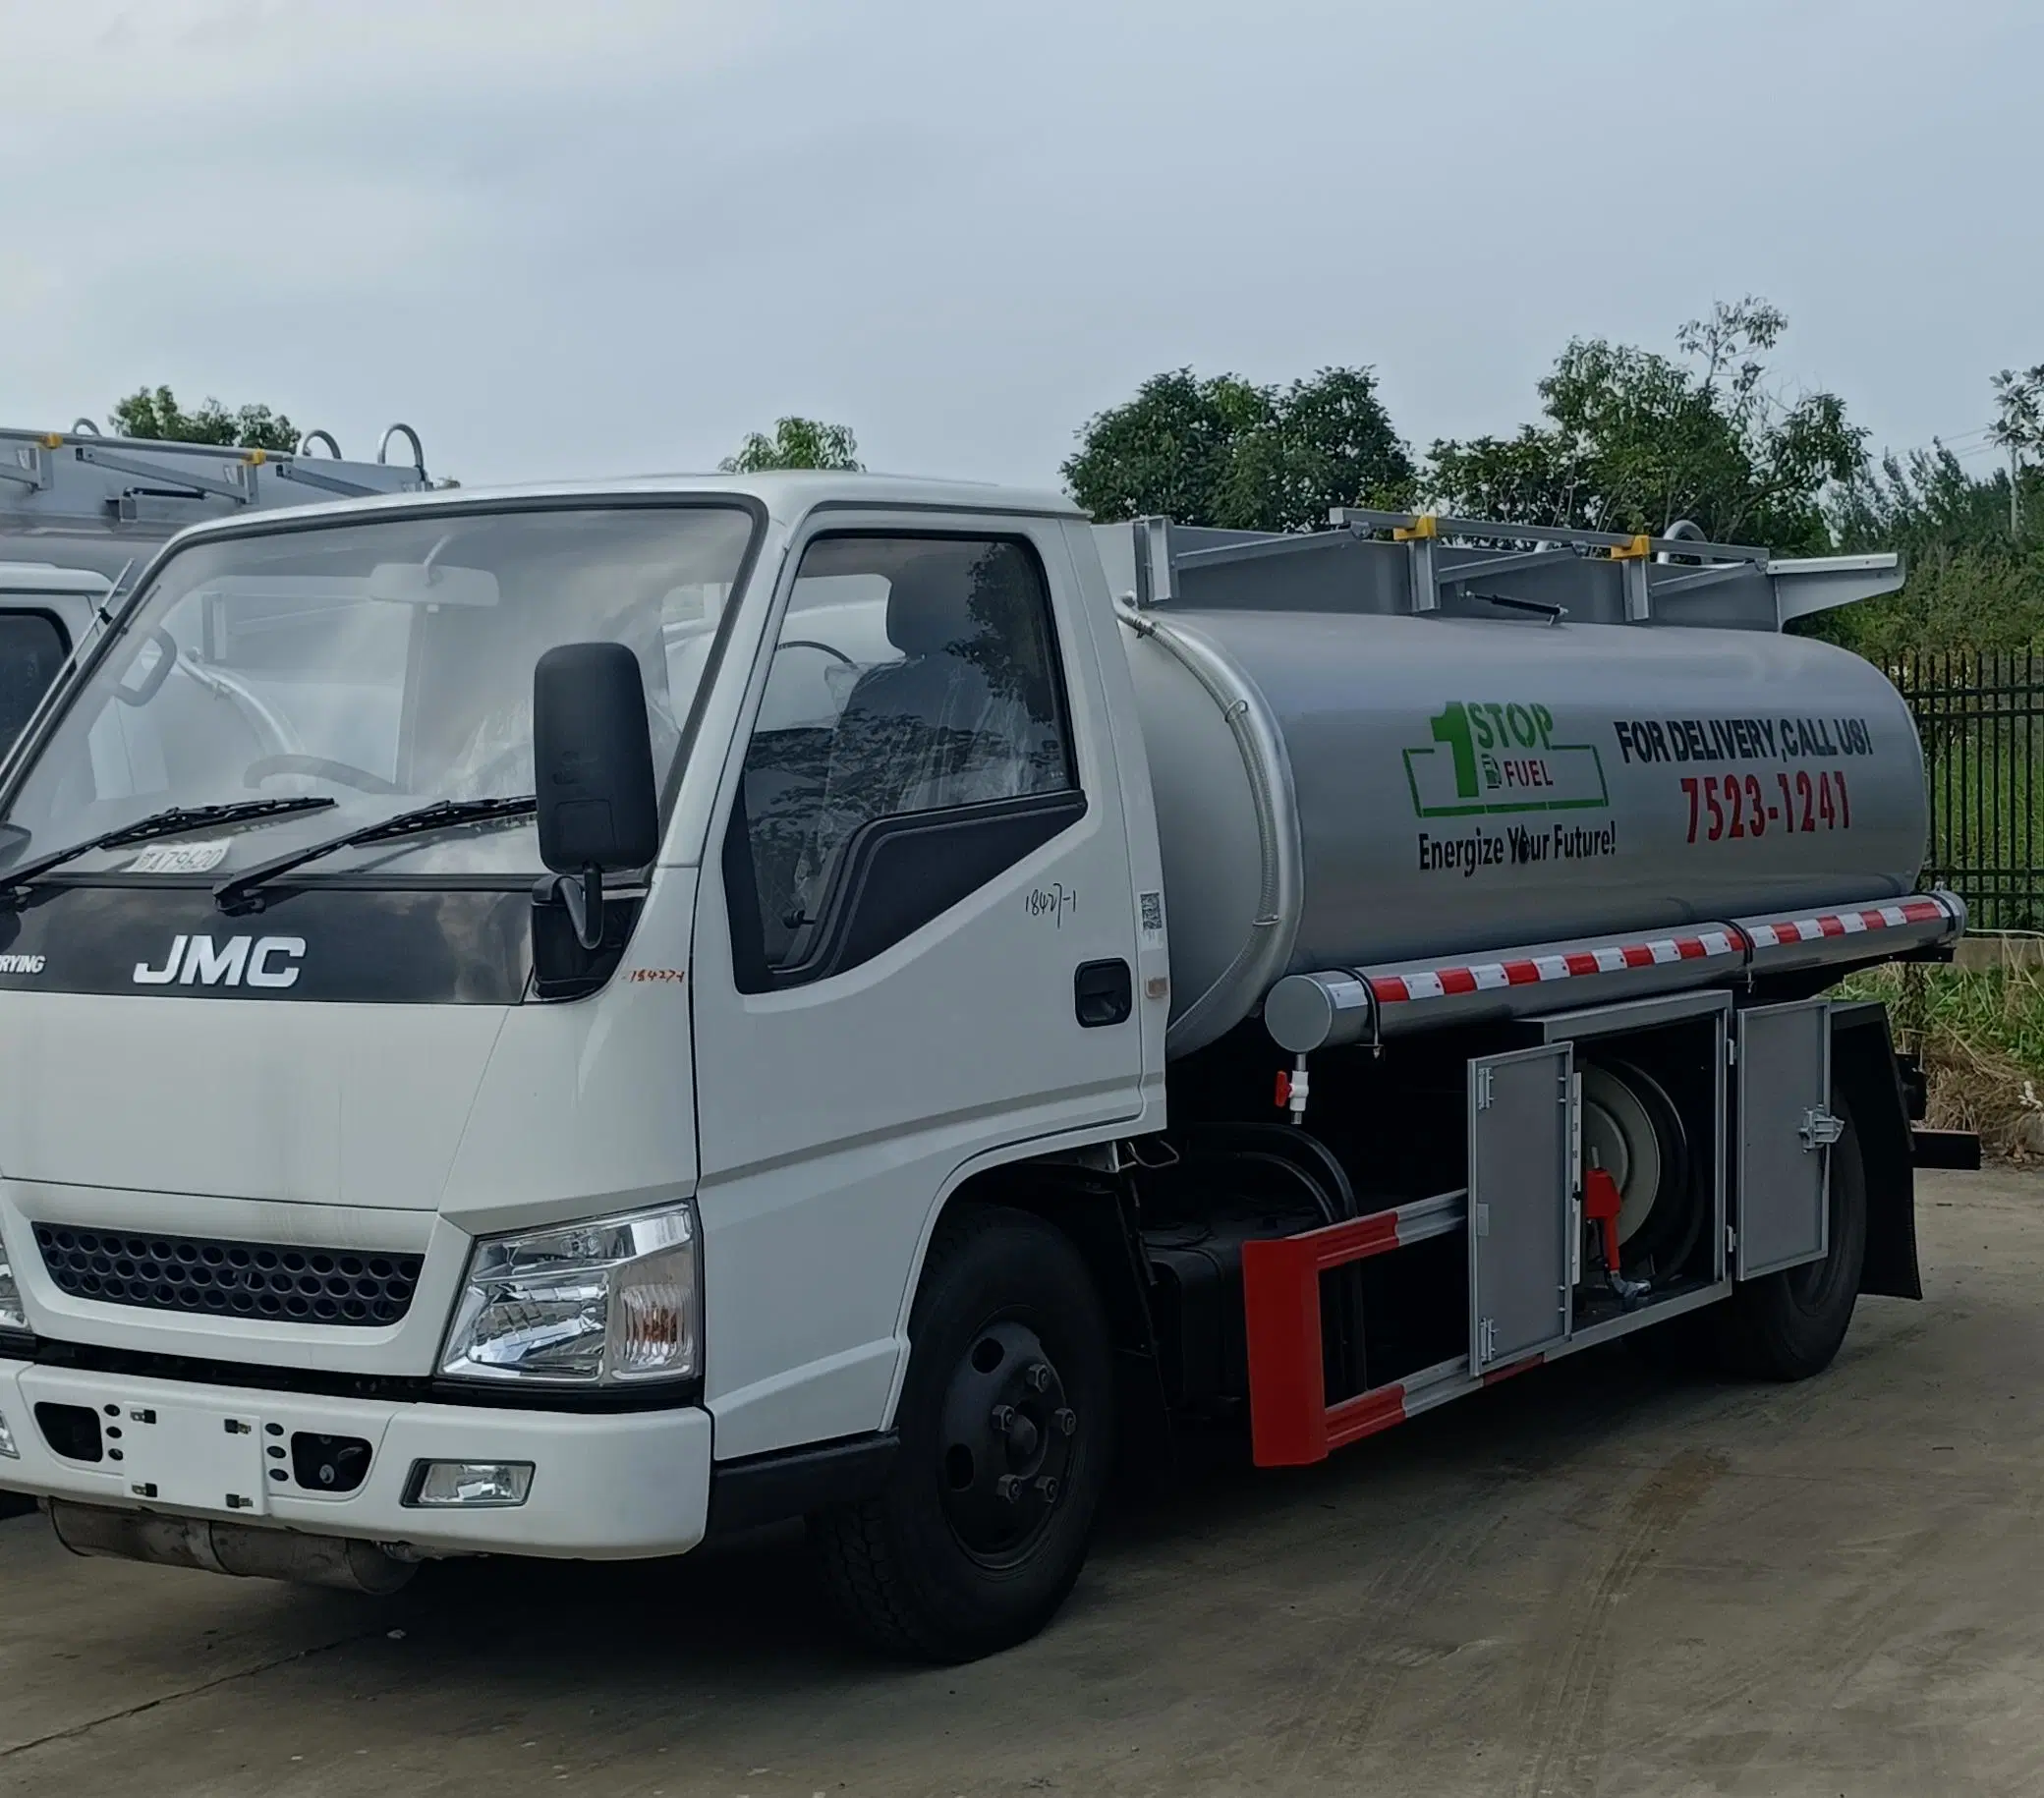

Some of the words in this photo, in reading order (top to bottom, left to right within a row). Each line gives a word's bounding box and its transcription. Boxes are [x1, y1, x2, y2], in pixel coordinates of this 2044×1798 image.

[1467, 702, 1554, 750] STOP
[1614, 720, 1672, 763] FOR
[1833, 718, 1874, 756] US!
[1503, 759, 1554, 787] FUEL
[1680, 770, 1849, 844] 7523-1241
[1418, 826, 1504, 877] Energize
[1506, 824, 1551, 865] Your
[1554, 820, 1617, 860] Future!
[1025, 882, 1076, 929] 18427-1
[0, 954, 46, 974] RYING
[133, 934, 307, 987] JMC
